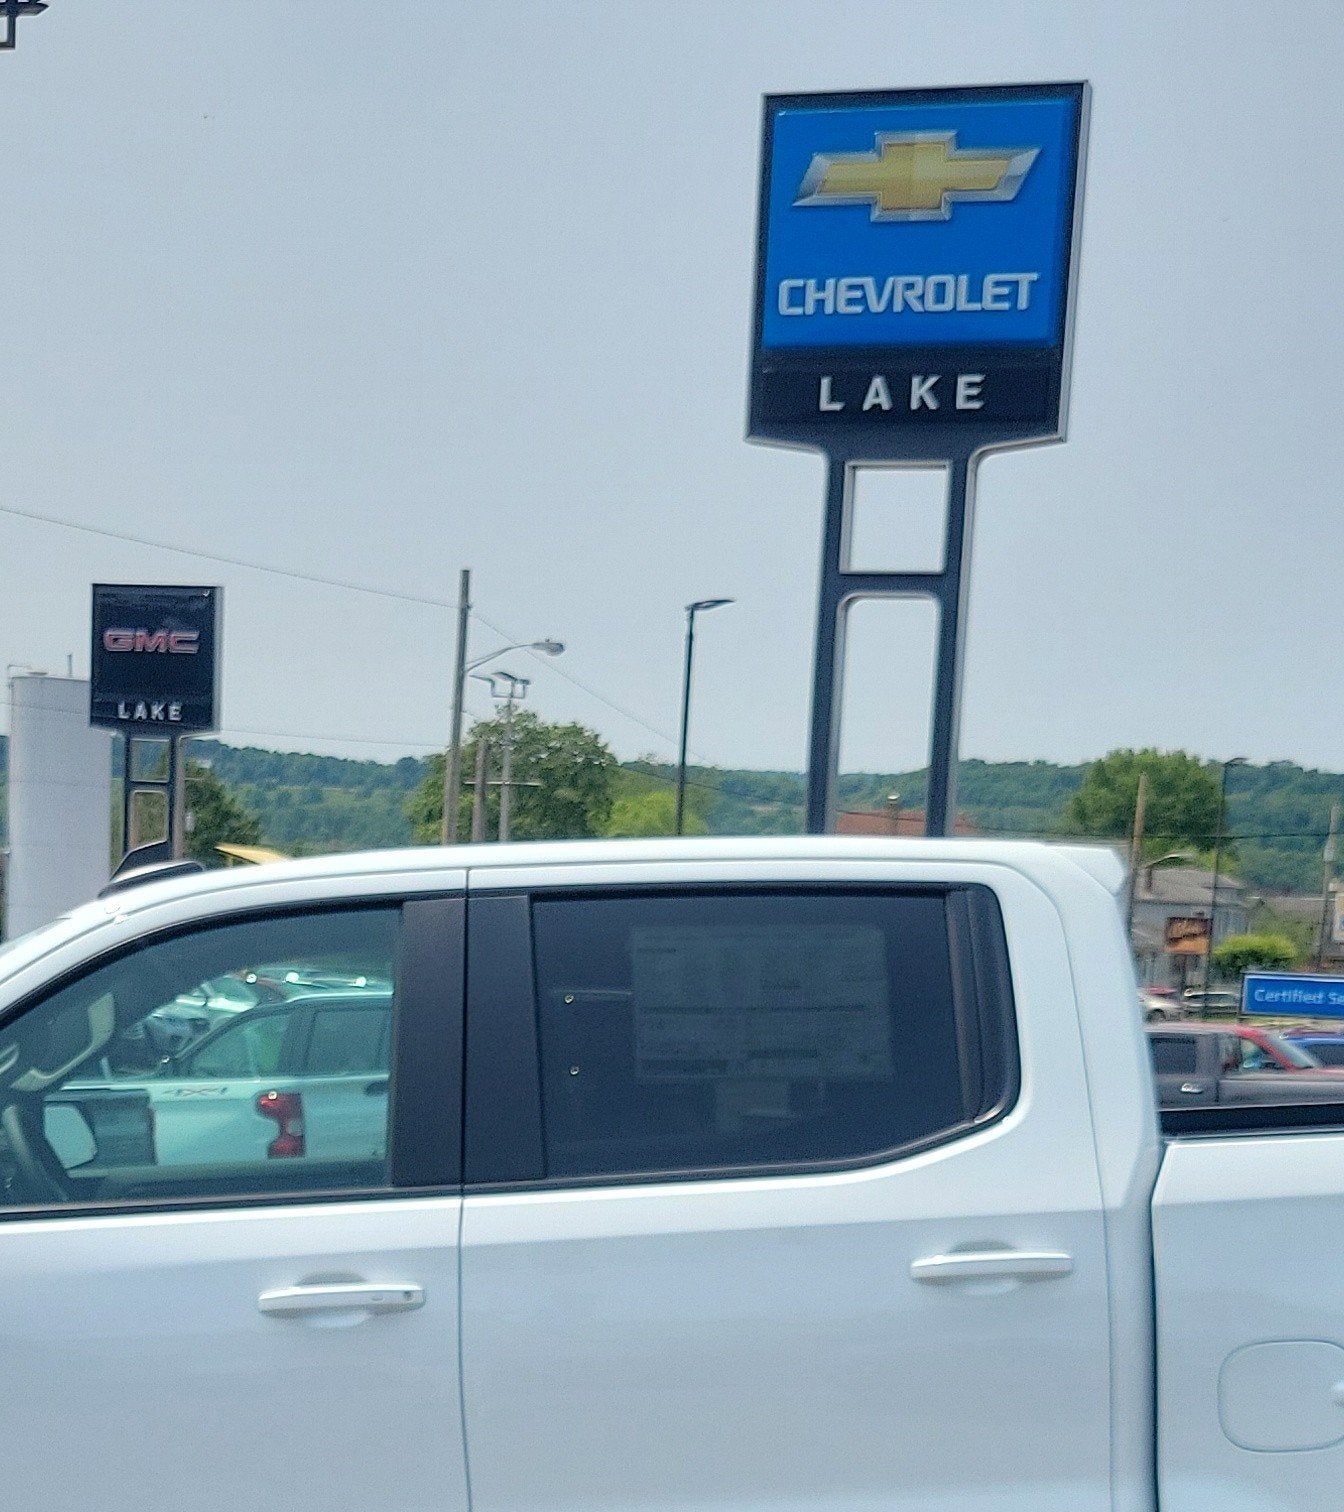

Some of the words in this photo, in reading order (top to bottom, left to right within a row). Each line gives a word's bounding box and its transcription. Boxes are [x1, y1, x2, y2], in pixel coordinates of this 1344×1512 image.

[778, 272, 1040, 316] CHEVROLET
[819, 373, 986, 412] LAKE
[103, 629, 199, 653] GMC
[117, 701, 182, 721] LAKE
[1255, 989, 1324, 1005] Certified
